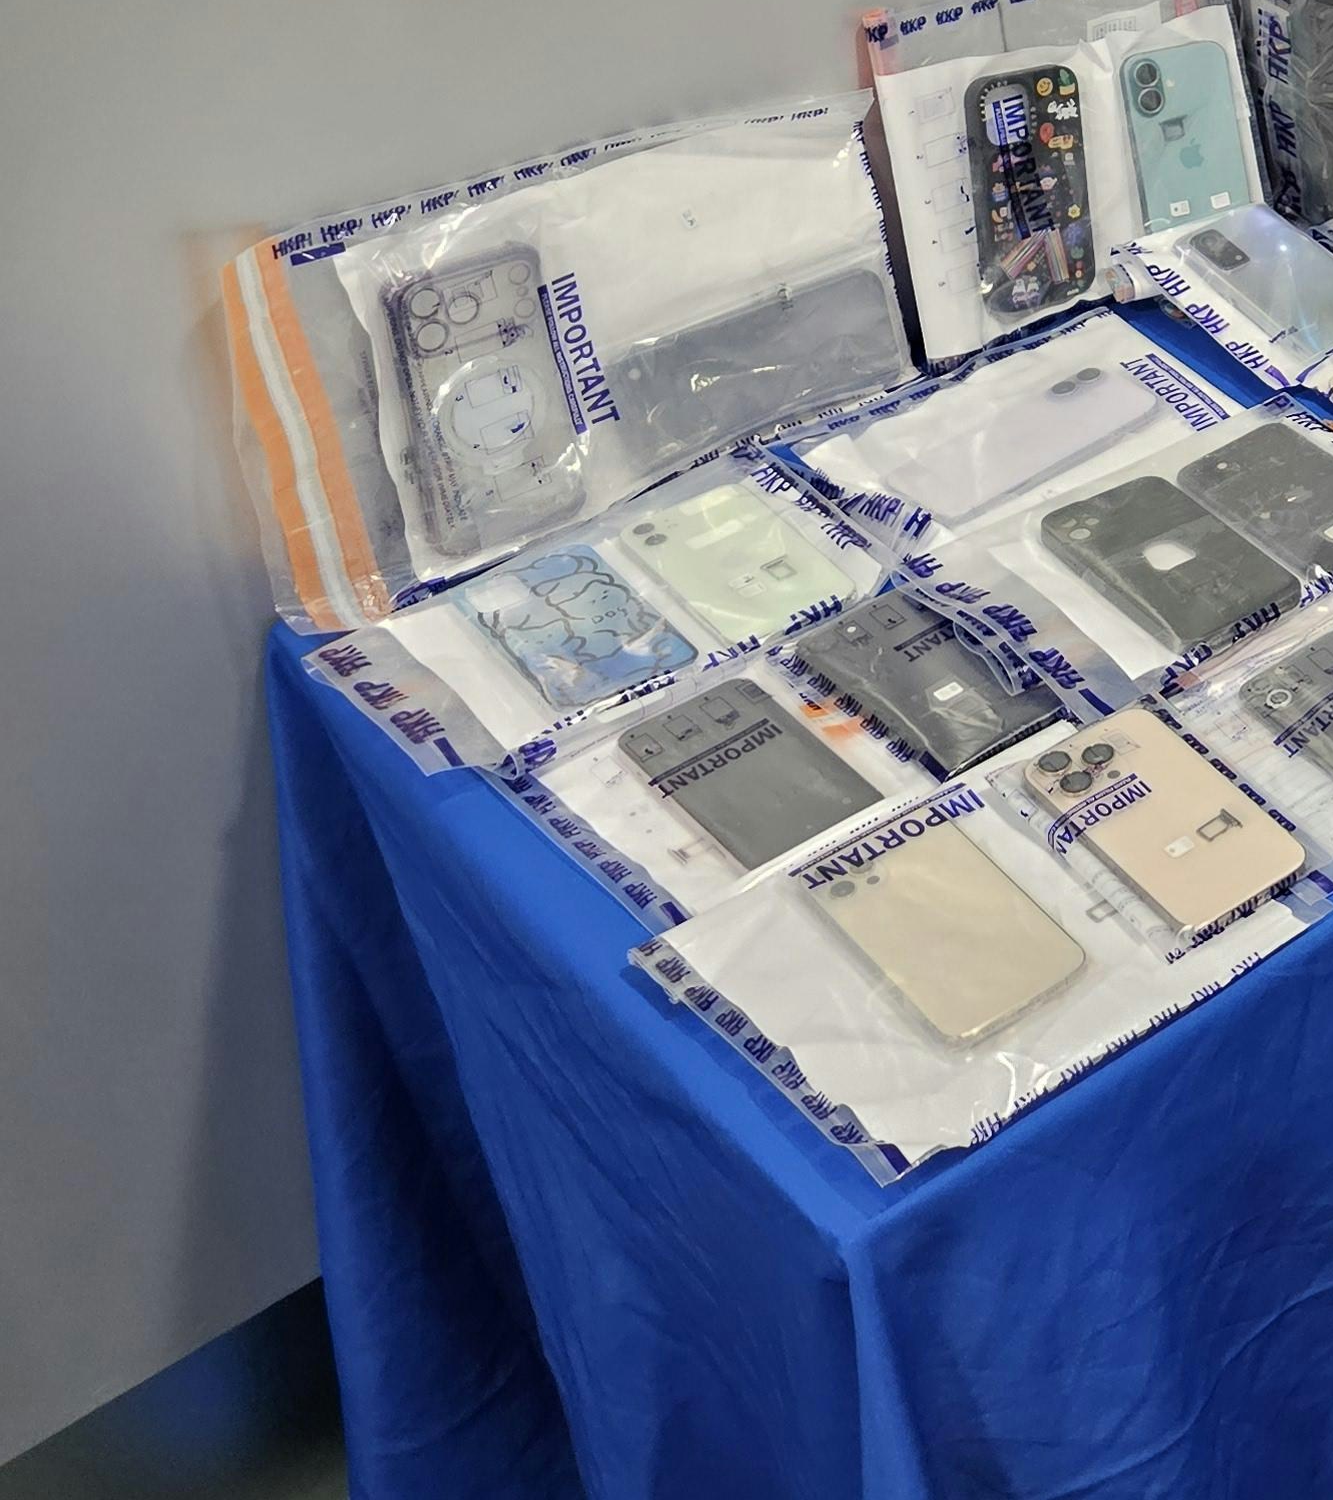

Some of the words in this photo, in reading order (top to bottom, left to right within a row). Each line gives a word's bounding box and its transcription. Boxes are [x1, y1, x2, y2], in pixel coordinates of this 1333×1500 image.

[865, 22, 888, 44] KP
[1268, 17, 1291, 85] HKP
[1003, 93, 1056, 233] IMPORTANT
[420, 190, 459, 214] HKP
[552, 272, 621, 425] IMPORTANT
[1147, 265, 1190, 297] HKP
[1185, 303, 1230, 334] HKP
[1225, 341, 1270, 370] HKP
[1120, 358, 1219, 431] IMPORTANT
[657, 721, 783, 799] IMPORTANT
[803, 788, 985, 889] IMPORTANT
[1053, 779, 1152, 856] IMPORTAN
